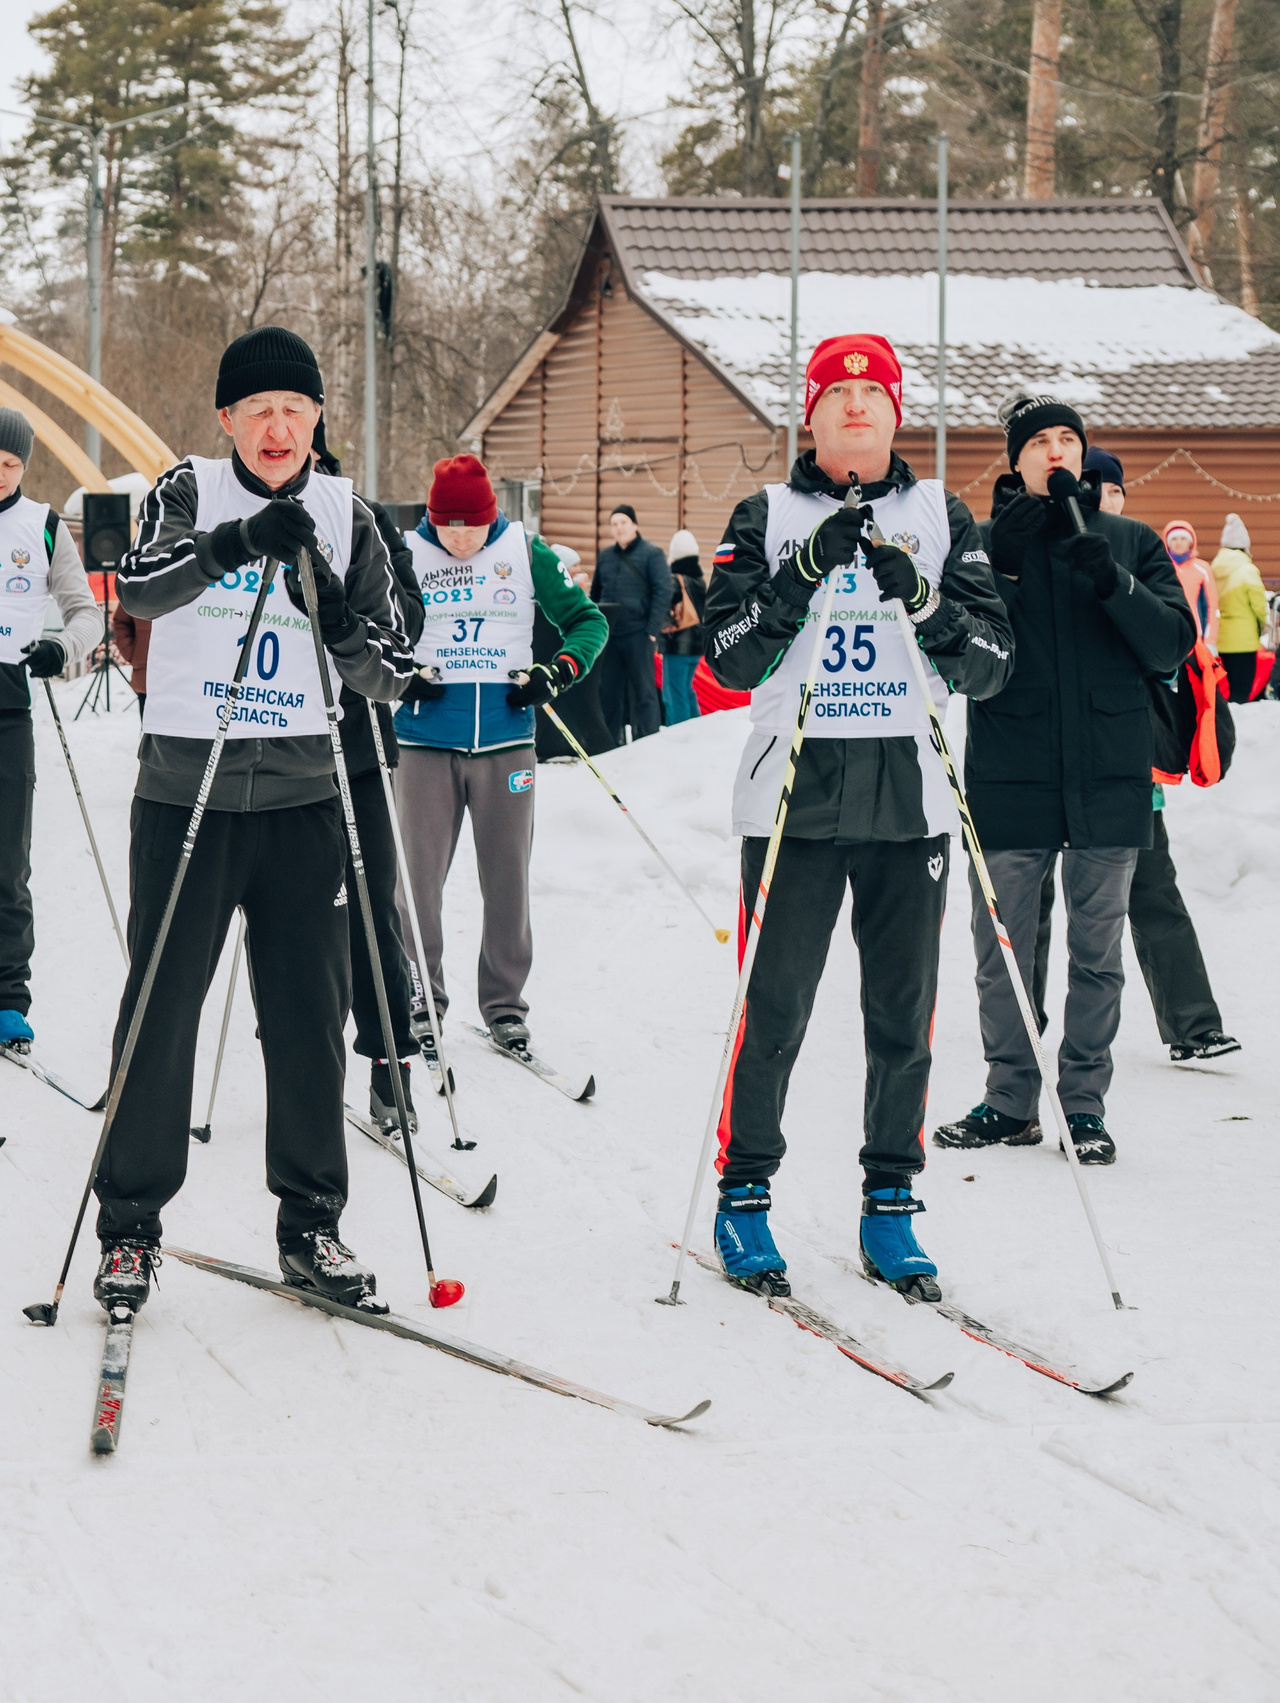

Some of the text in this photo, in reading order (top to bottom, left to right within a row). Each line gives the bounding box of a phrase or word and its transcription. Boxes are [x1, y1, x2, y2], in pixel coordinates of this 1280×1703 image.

[421, 565, 473, 584] ЛЫЖНЯ
[421, 576, 474, 591] РОССИИ
[422, 588, 473, 605] 2023
[197, 605, 235, 620] СПОРТ
[829, 610, 878, 622] НОРМА
[452, 618, 485, 643] 37
[437, 647, 507, 658] ПЕНЗЕНСКАЯ
[822, 625, 877, 673] 35
[445, 659, 498, 670] ОБЛАСТЬ
[815, 702, 892, 717] ОБЛАСТЬ
[730, 1199, 771, 1208] SPINE
[876, 1204, 919, 1212] SPINE
